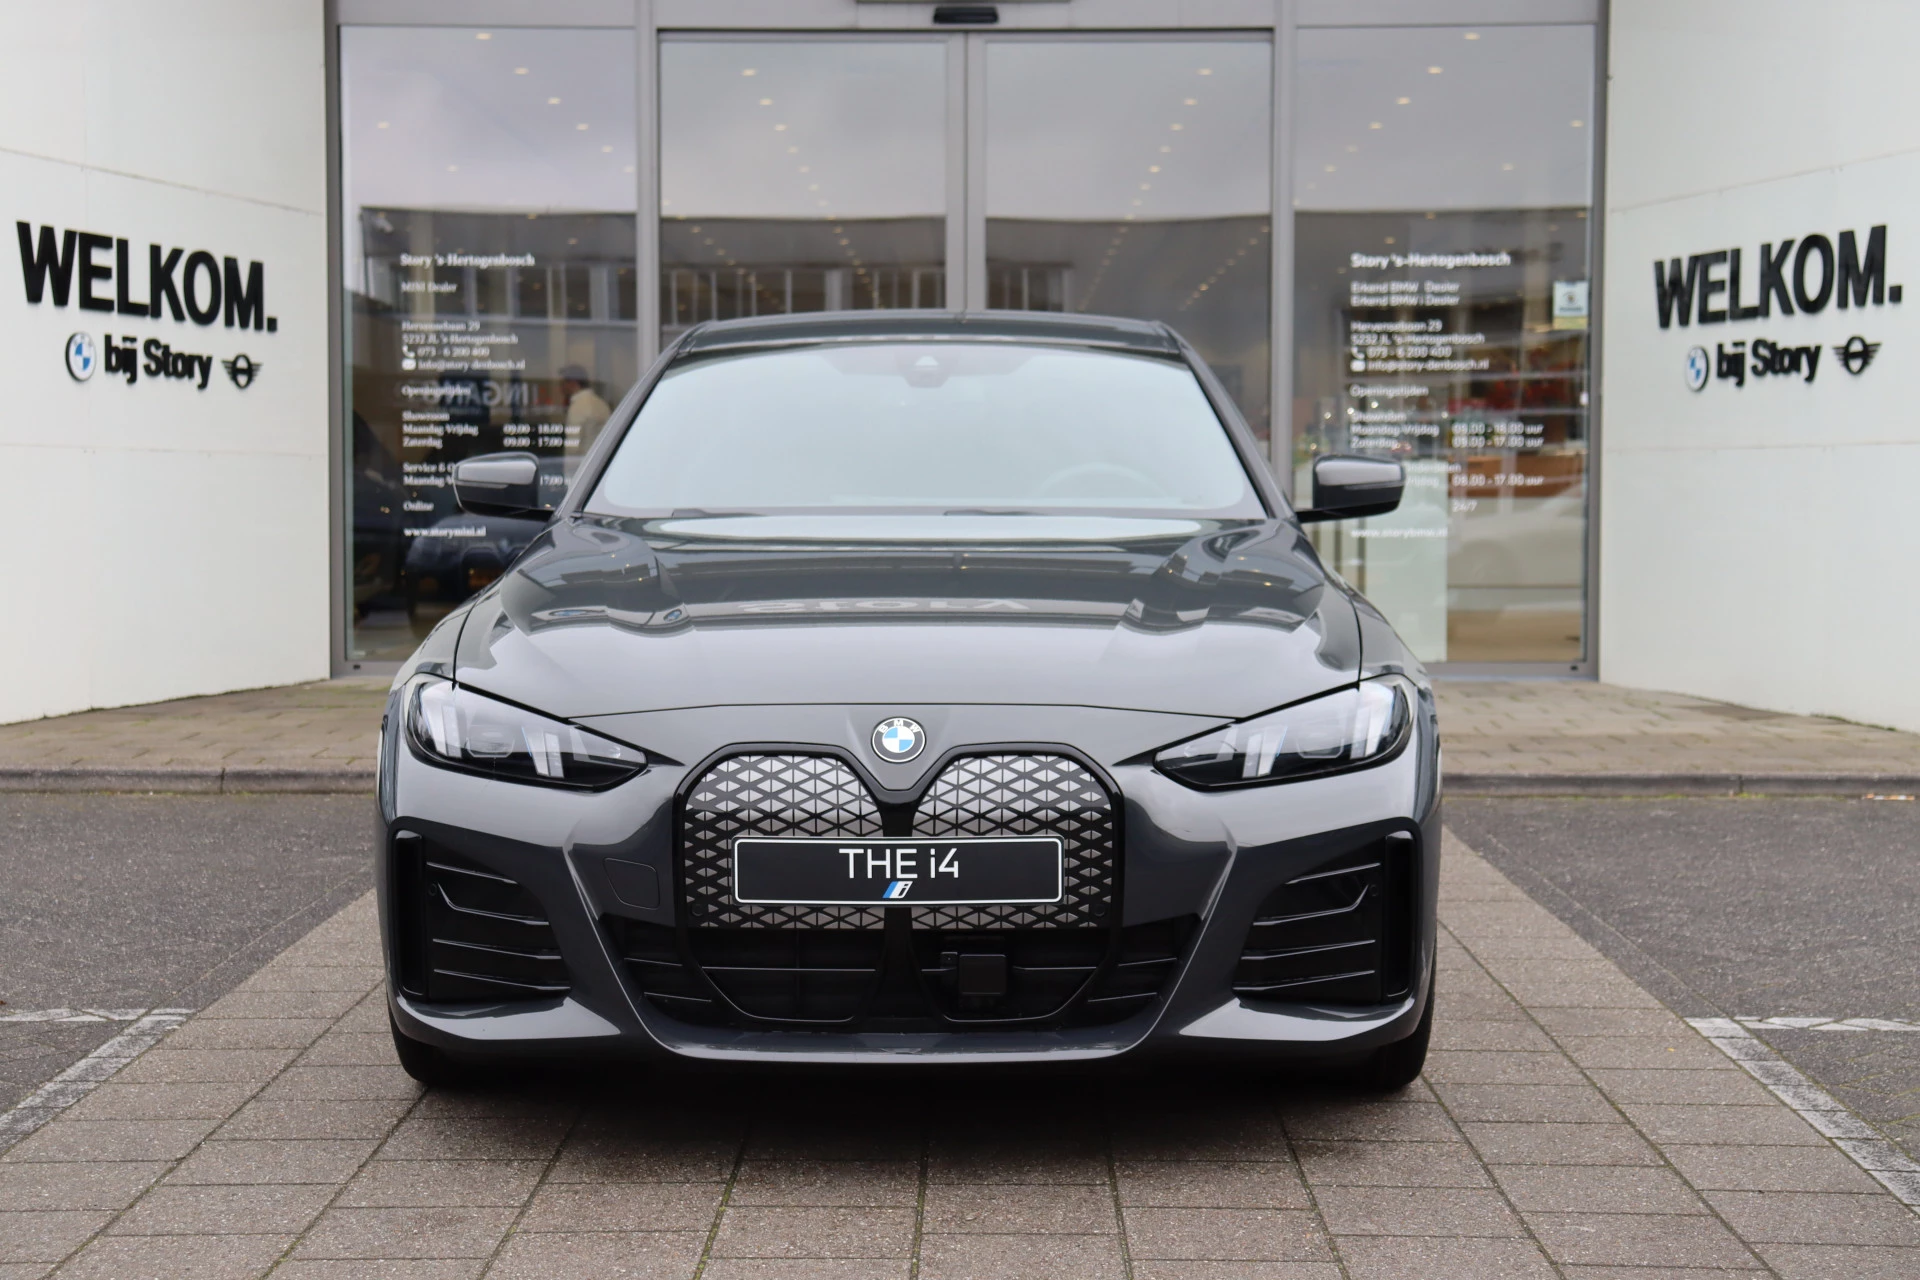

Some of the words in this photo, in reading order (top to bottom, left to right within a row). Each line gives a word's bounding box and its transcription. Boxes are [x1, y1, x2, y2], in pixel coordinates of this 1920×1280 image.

[400, 253, 434, 269] Story
[1351, 252, 1389, 270] Story
[16, 220, 277, 332] WELKOM.
[1654, 224, 1903, 330] WELKOM.
[1351, 281, 1388, 293] Erkend
[1390, 281, 1419, 293] BMW
[1424, 281, 1460, 293] Dealer
[1351, 294, 1388, 306] Erkend
[1390, 294, 1419, 306] BMW
[1424, 294, 1460, 306] Dealer
[468, 320, 480, 331] 29
[1428, 319, 1442, 331] 29
[104, 334, 137, 384] bij
[143, 338, 212, 390] Story
[1717, 341, 1745, 387] bij
[1752, 338, 1822, 383] Story
[1526, 425, 1544, 435] uur
[1526, 437, 1544, 447] uur
[1406, 462, 1462, 473] nderdelen
[1525, 476, 1545, 486] uur
[1452, 500, 1477, 512] 24/7
[839, 848, 918, 879] THE
[930, 848, 959, 879] i4
